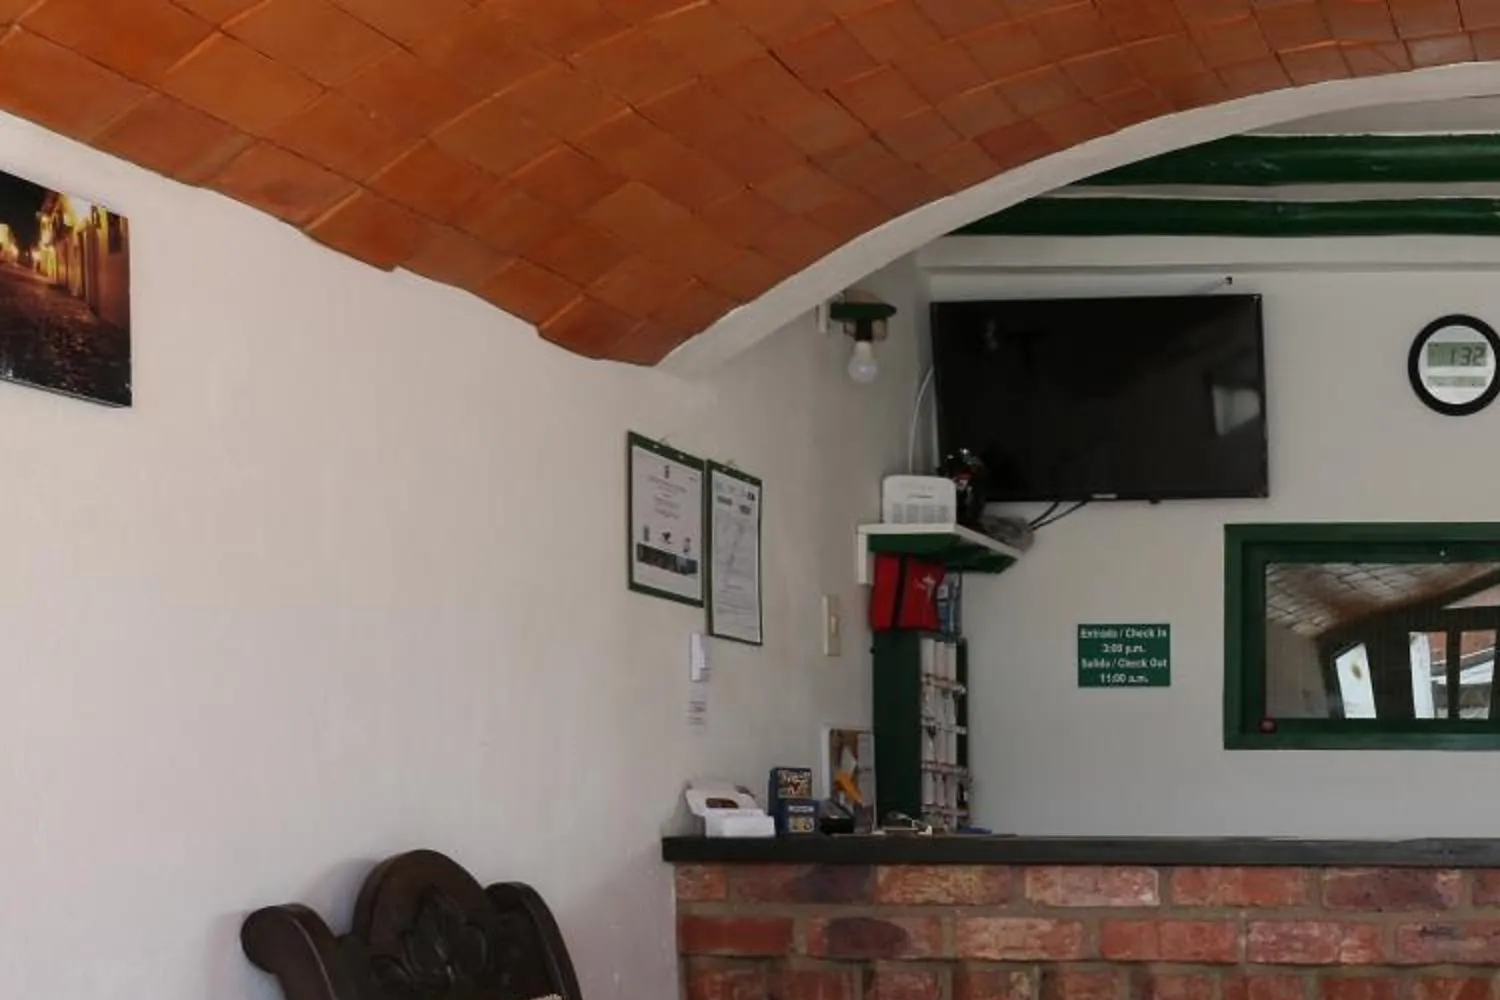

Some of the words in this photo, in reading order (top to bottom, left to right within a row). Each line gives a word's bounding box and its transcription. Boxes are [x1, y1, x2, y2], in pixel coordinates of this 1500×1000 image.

[1125, 627, 1154, 639] Check
[1157, 627, 1167, 638] In
[1117, 657, 1147, 669] Check
[1149, 657, 1168, 668] Out
